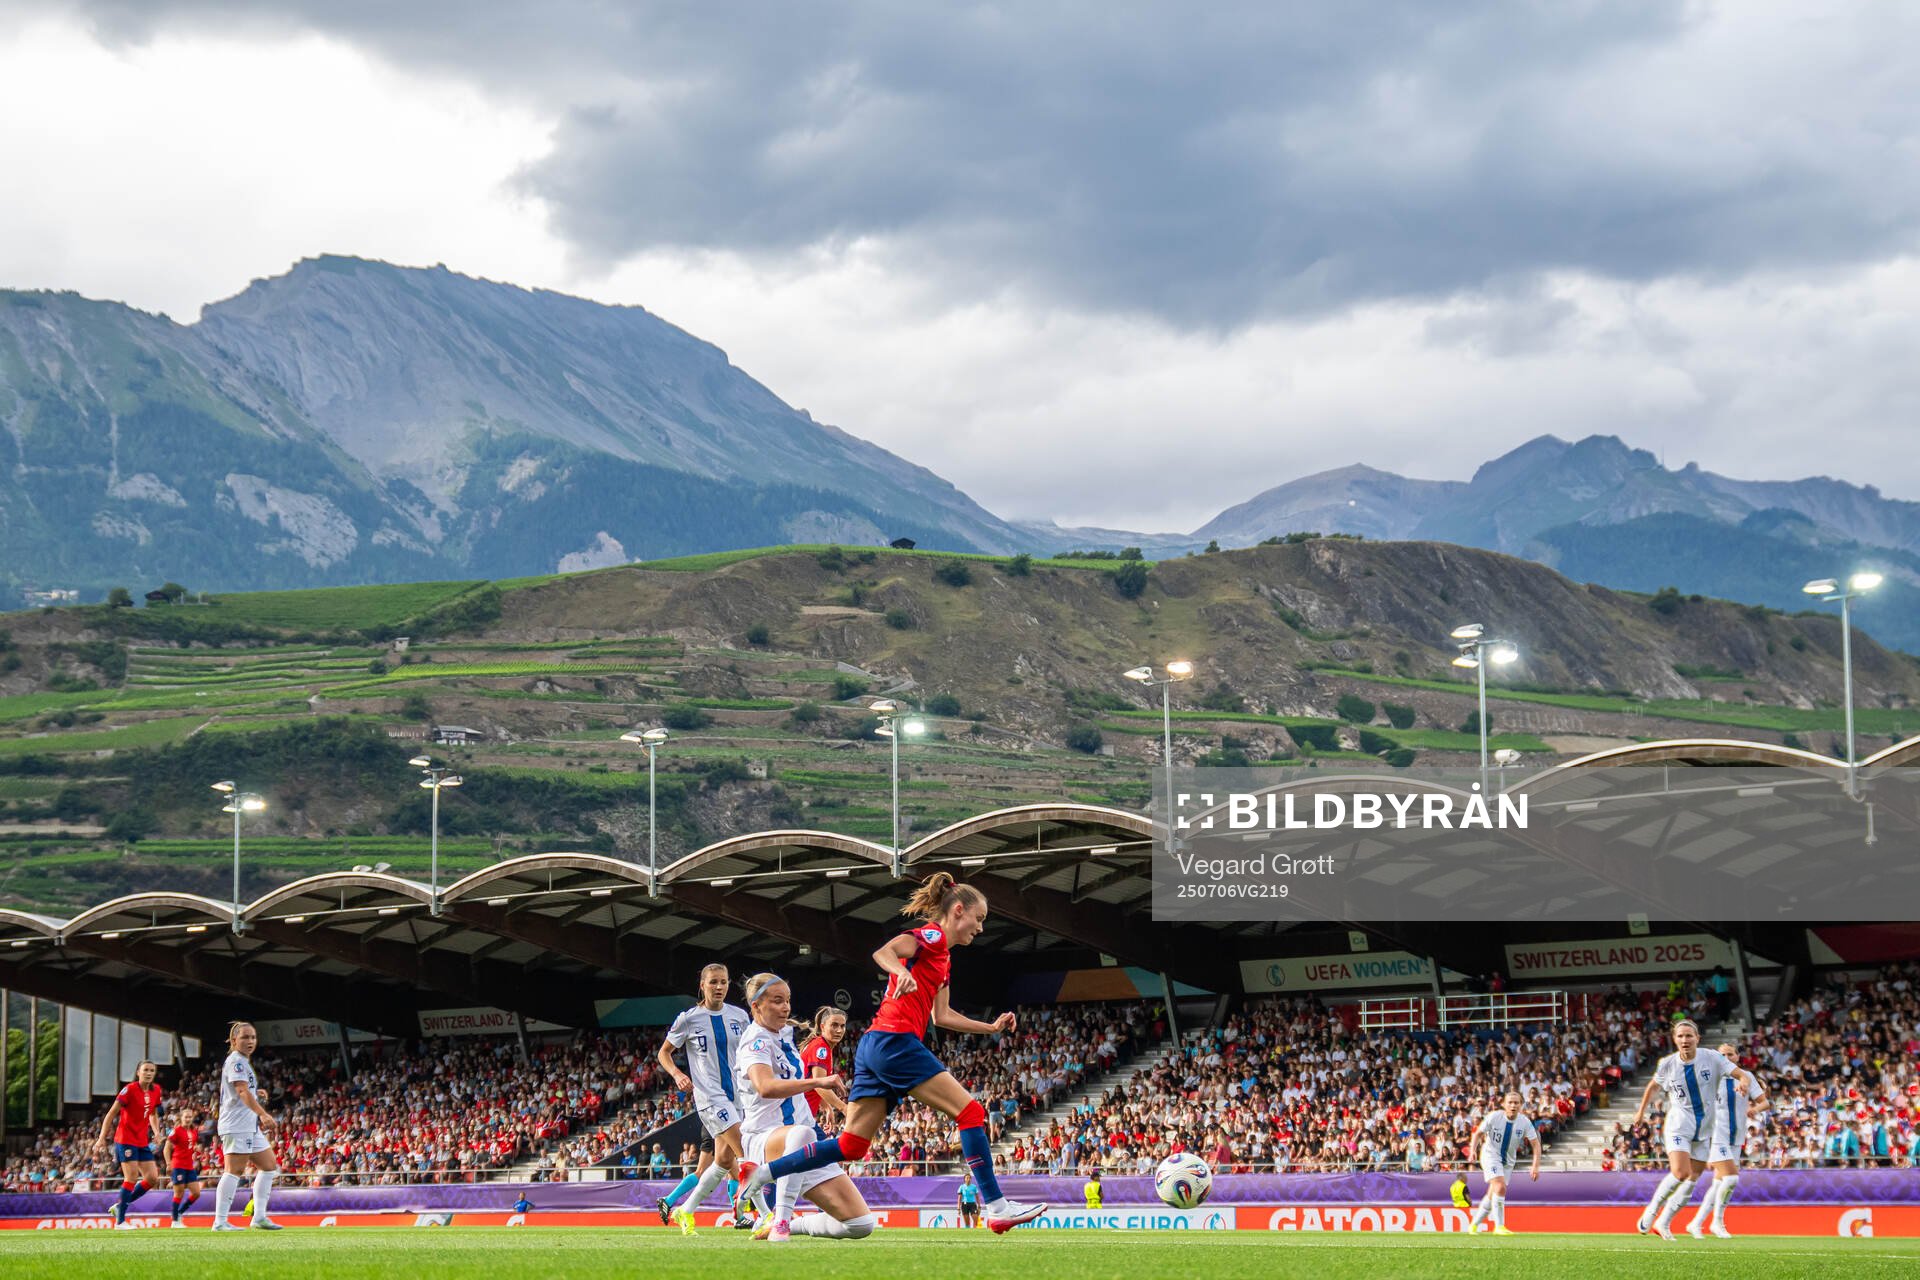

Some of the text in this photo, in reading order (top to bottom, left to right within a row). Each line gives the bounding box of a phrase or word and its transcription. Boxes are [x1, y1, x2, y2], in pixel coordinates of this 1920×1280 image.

[1513, 944, 1705, 970] SWITZERLAND 2025
[1305, 963, 1352, 981] UEFA
[423, 1013, 503, 1031] SWITZERLAND
[295, 1024, 324, 1038] UEFA
[1492, 1131, 1502, 1143] 13
[37, 1217, 160, 1230] GATORDE
